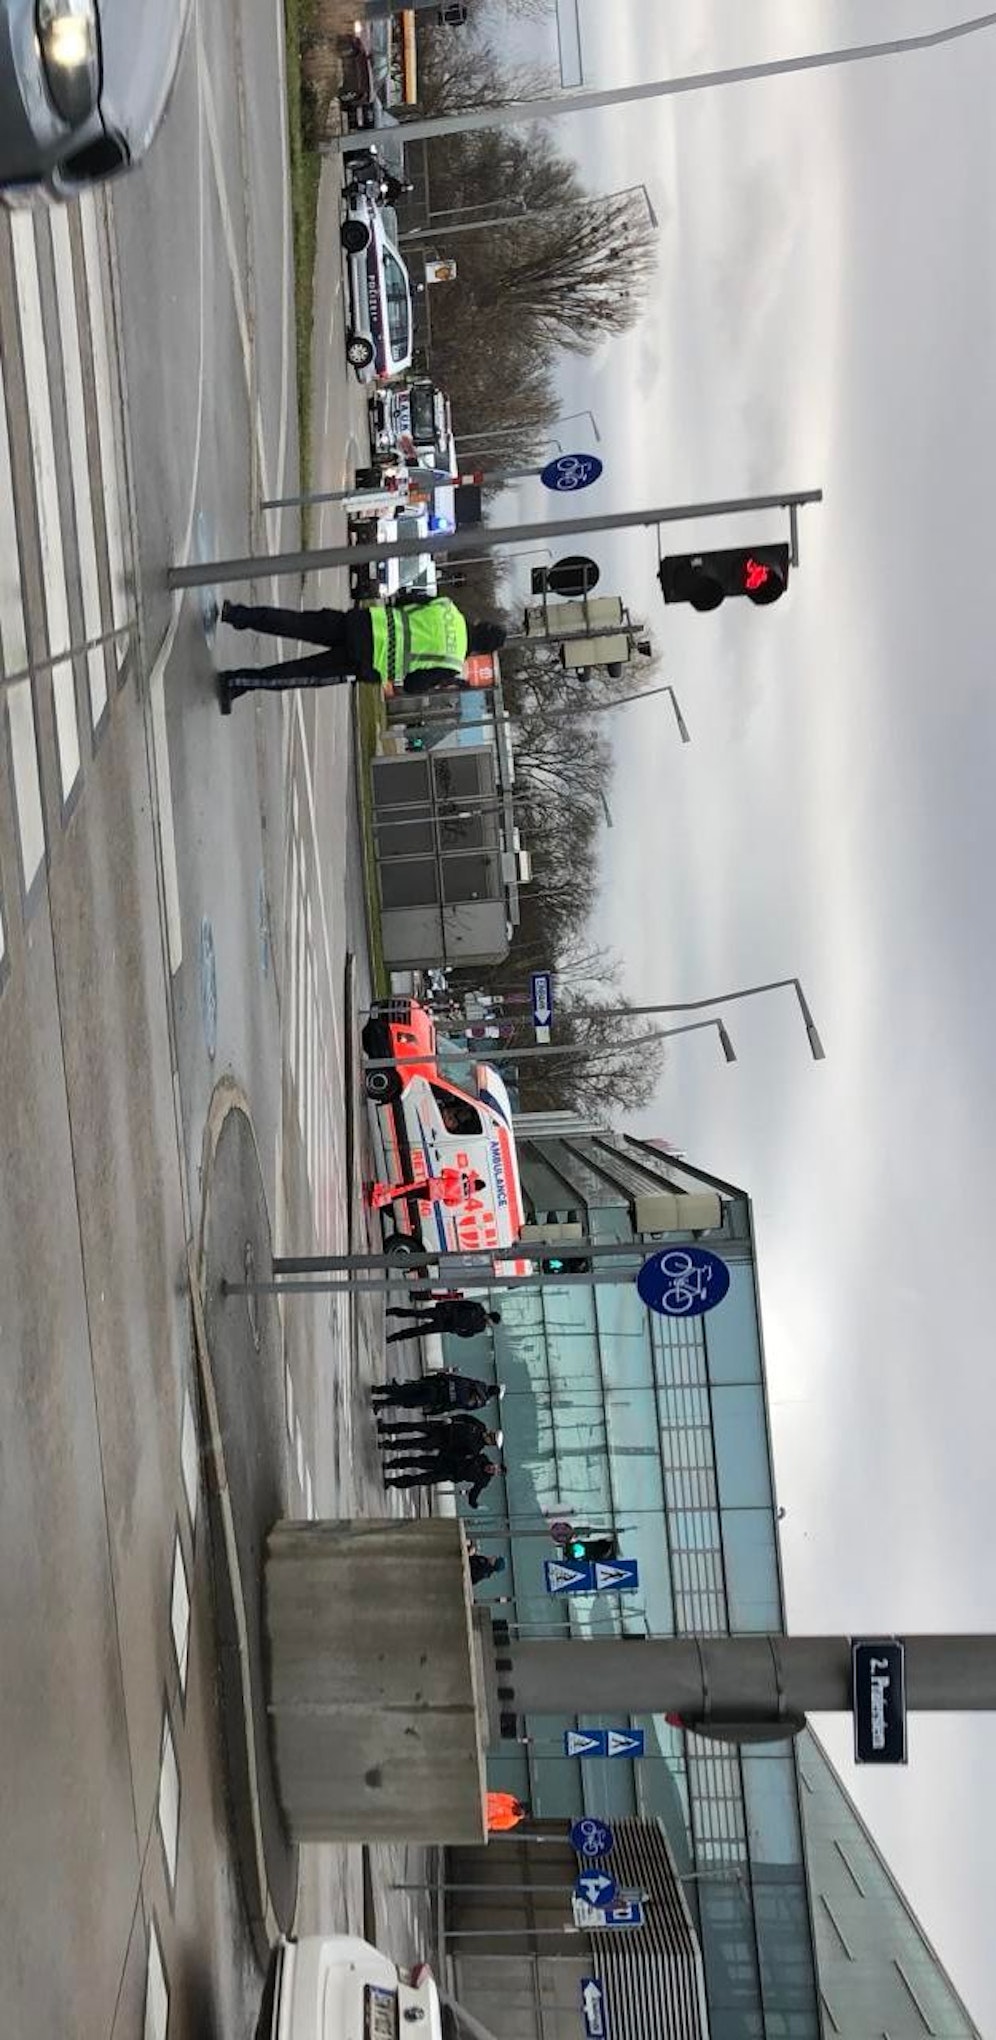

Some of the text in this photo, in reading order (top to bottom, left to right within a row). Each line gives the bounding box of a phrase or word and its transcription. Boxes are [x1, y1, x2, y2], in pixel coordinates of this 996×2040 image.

[367, 274, 379, 317] POLIZEI
[412, 1151, 432, 1217] RETNG
[490, 1141, 507, 1208] AMBULANCE
[870, 1658, 889, 1675] 2.
